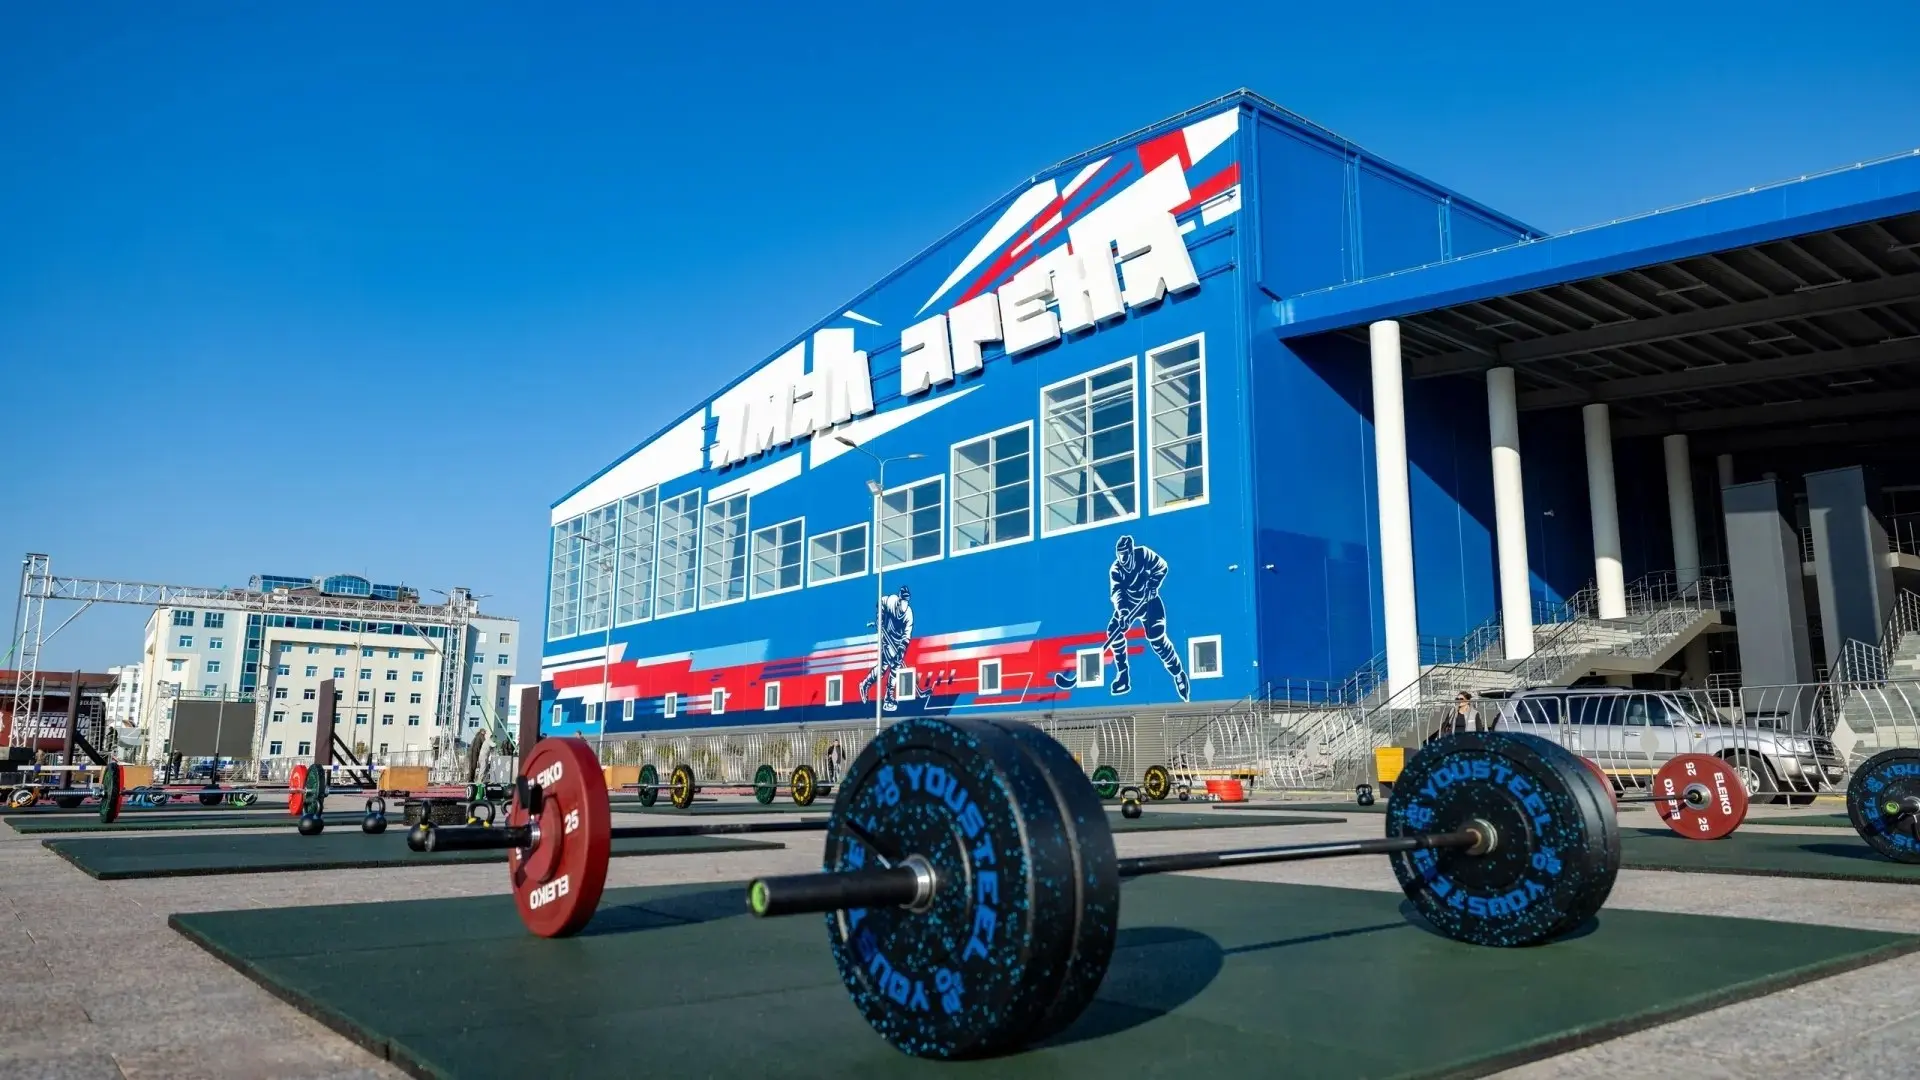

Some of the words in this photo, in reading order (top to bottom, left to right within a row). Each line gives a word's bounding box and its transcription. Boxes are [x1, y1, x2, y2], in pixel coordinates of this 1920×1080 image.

[1685, 761, 1697, 777] 25
[1420, 759, 1552, 837] YOUSTEEL
[1663, 778, 1681, 820] ELEKO
[1713, 771, 1732, 816] ELEIKO
[564, 808, 579, 835] 25
[1696, 817, 1710, 832] 25
[903, 762, 999, 963] YOUSTEEL
[529, 874, 570, 910] ELEIKO
